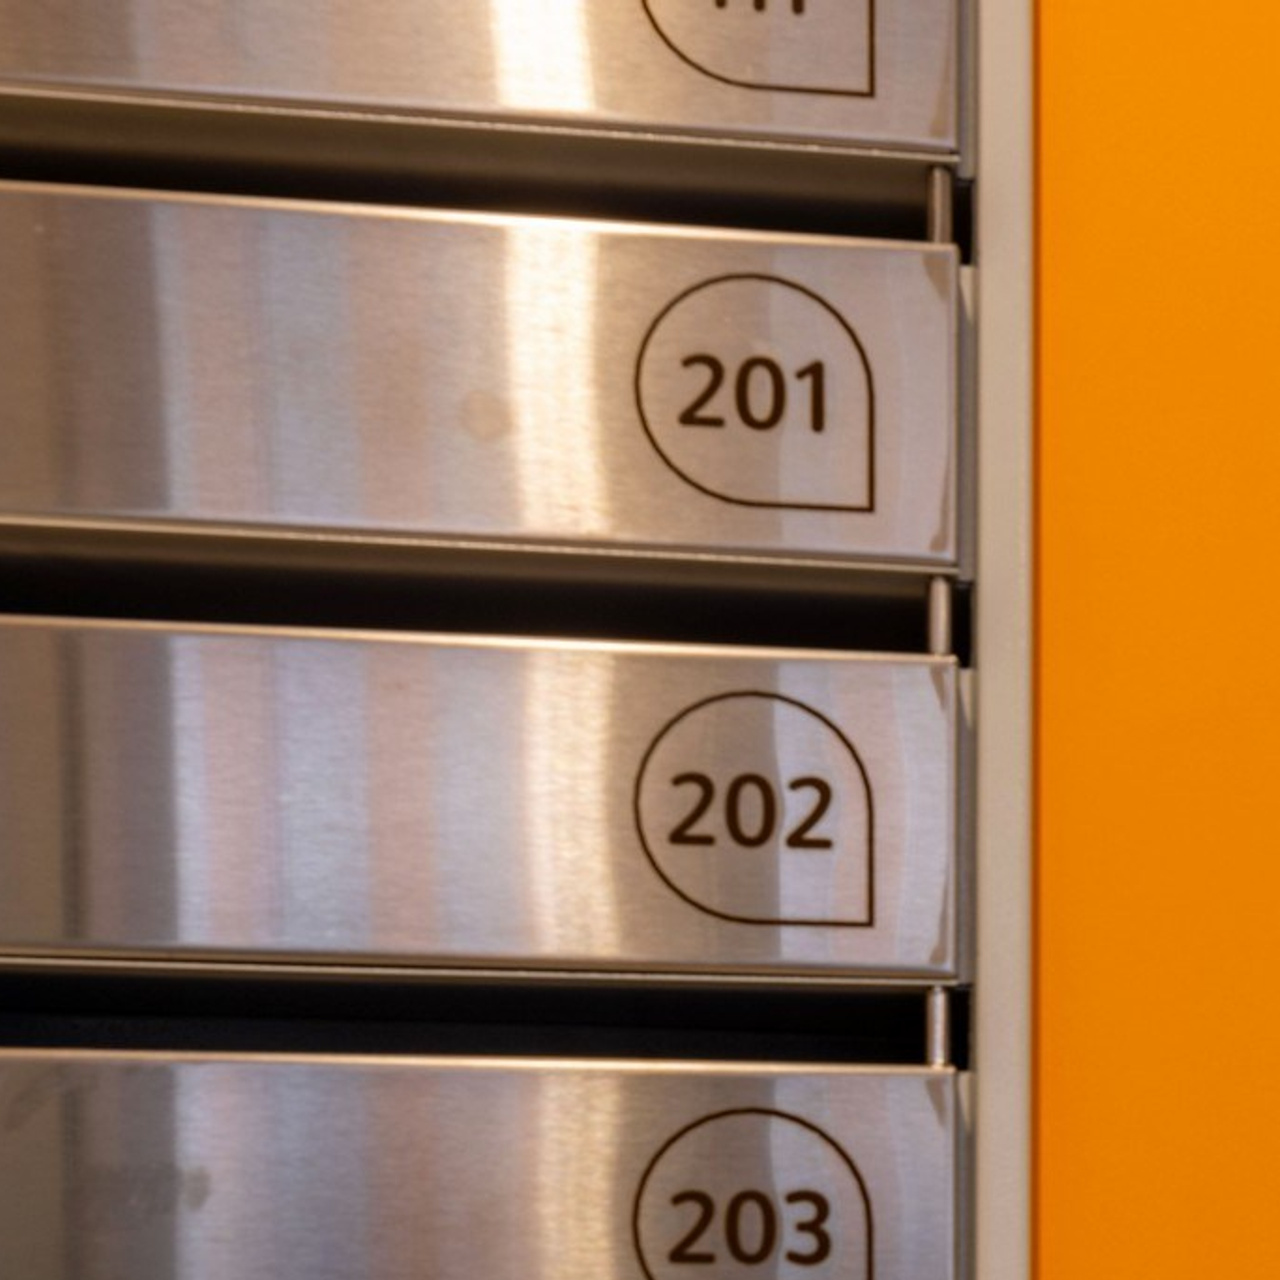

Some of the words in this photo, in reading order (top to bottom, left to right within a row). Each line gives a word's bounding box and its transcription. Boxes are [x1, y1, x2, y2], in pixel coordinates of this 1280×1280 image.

[679, 354, 825, 433] 201
[669, 773, 833, 850] 202
[669, 1190, 831, 1266] 203
